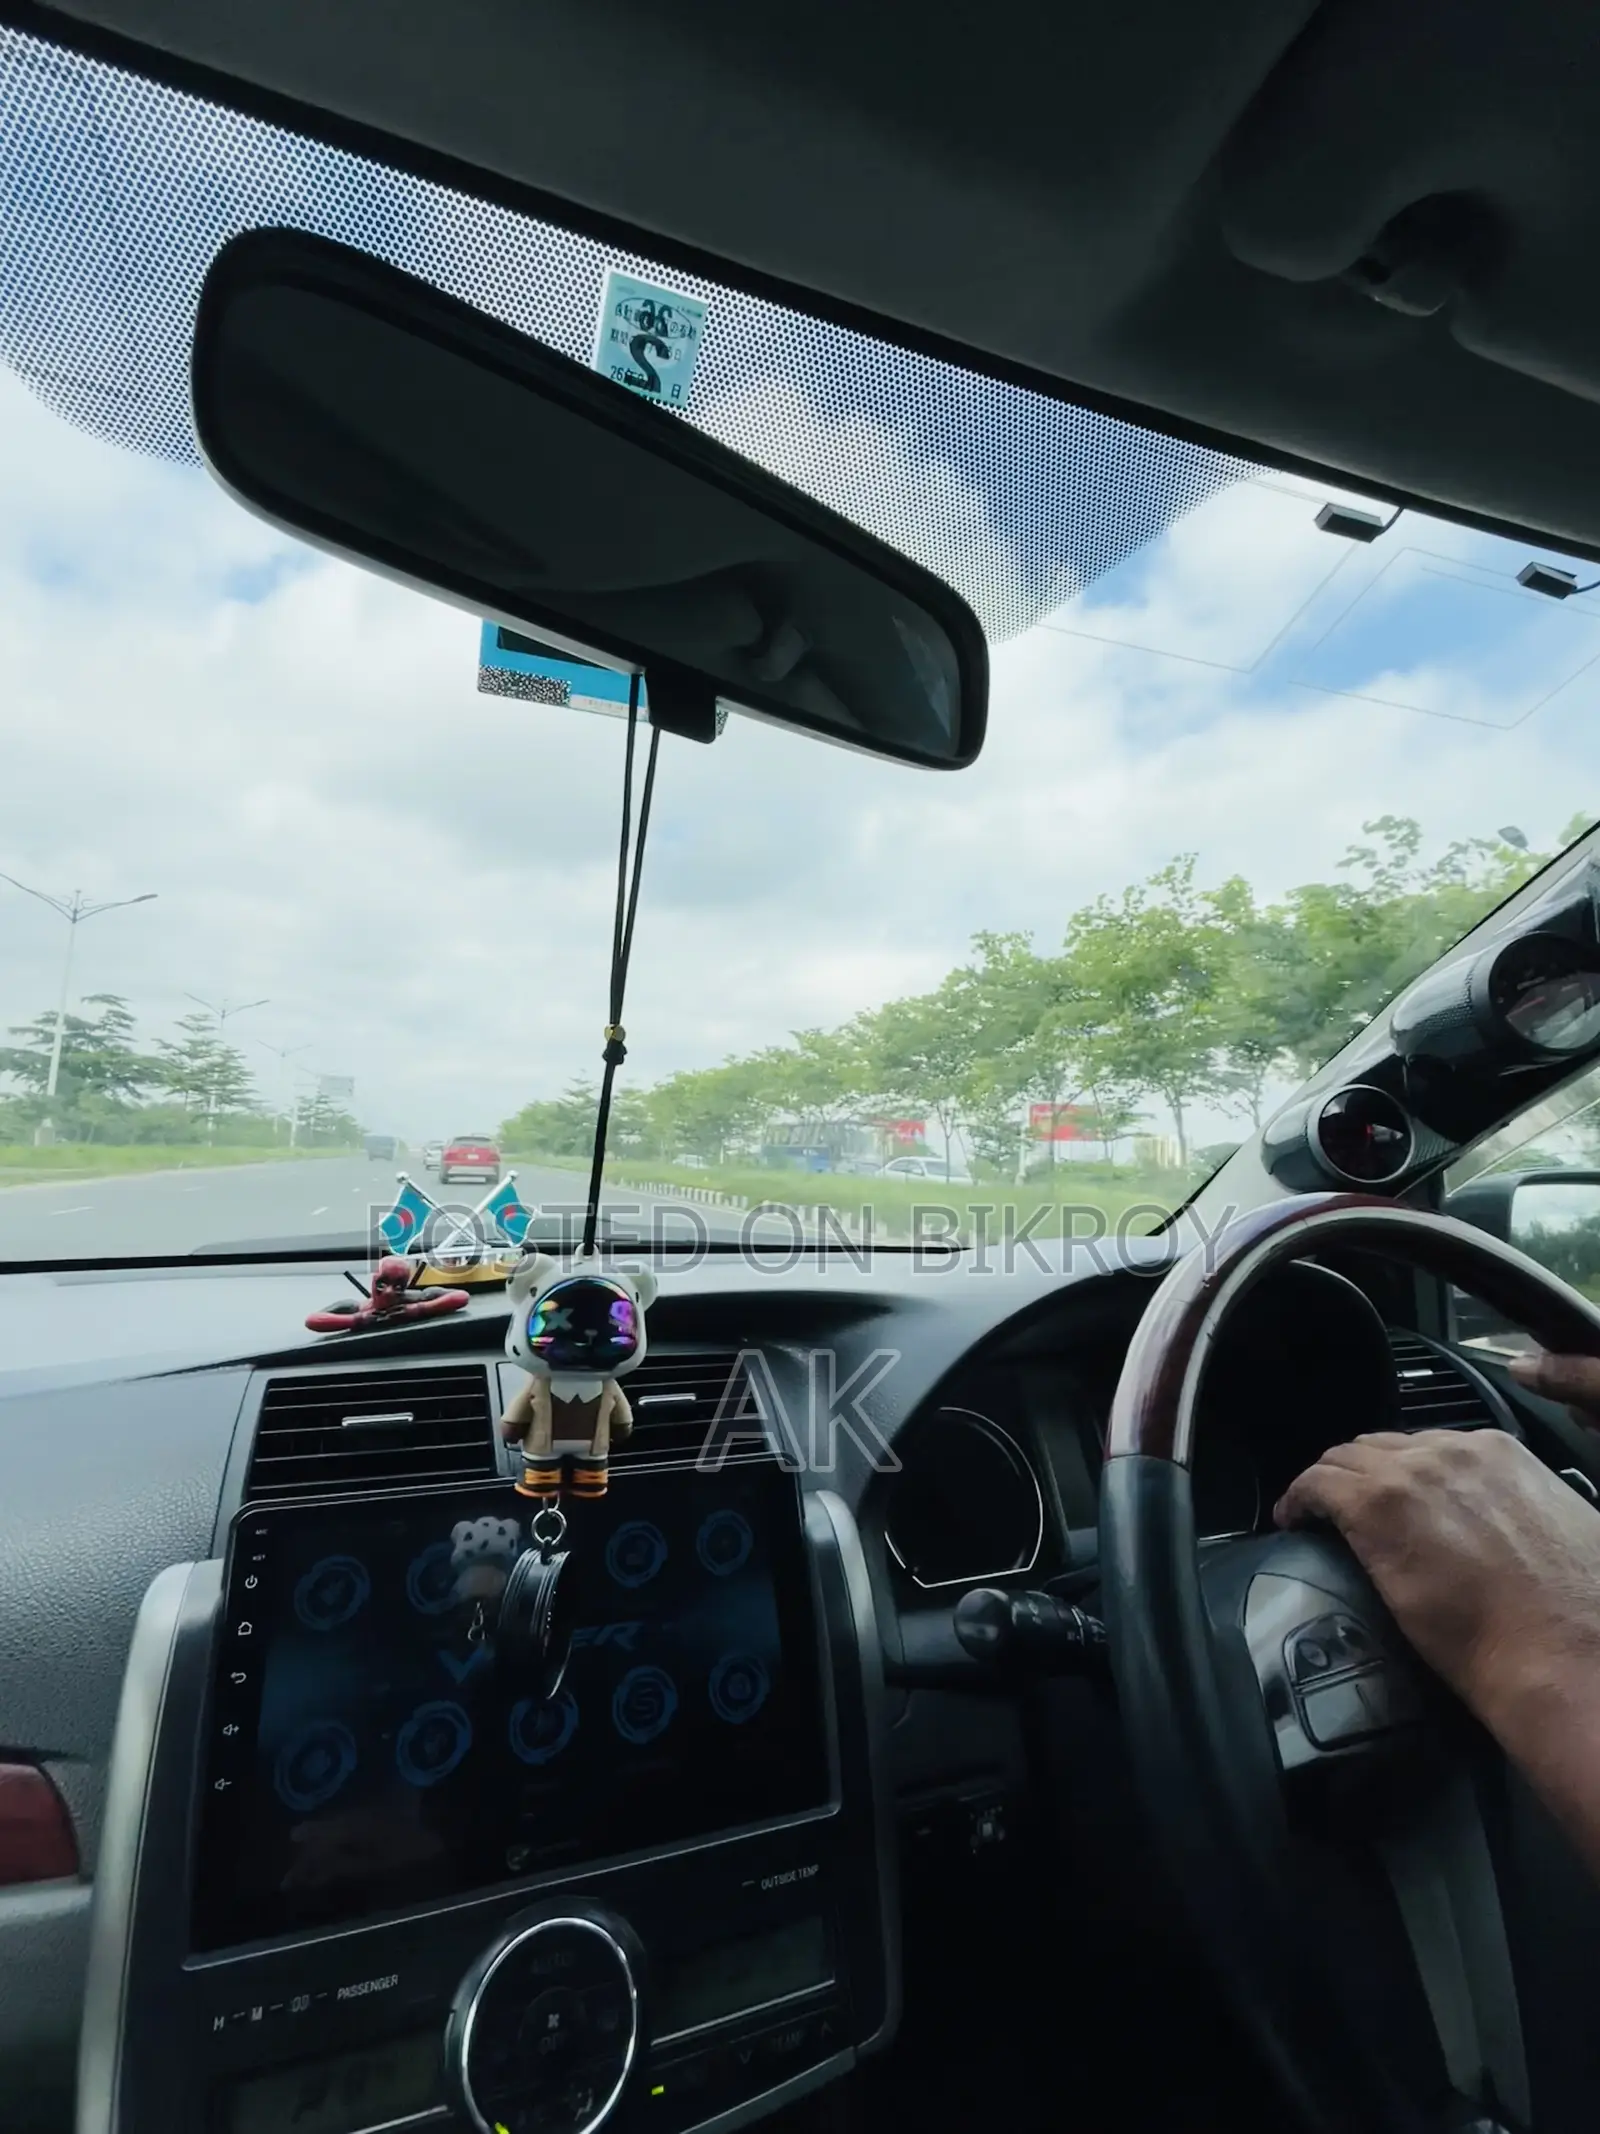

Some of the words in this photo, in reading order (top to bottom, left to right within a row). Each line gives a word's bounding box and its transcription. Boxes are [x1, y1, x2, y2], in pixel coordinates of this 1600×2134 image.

[761, 1869, 796, 1891] OUTSIDE
[797, 1863, 820, 1879] TEMP
[336, 1974, 399, 2000] PASSENGER
